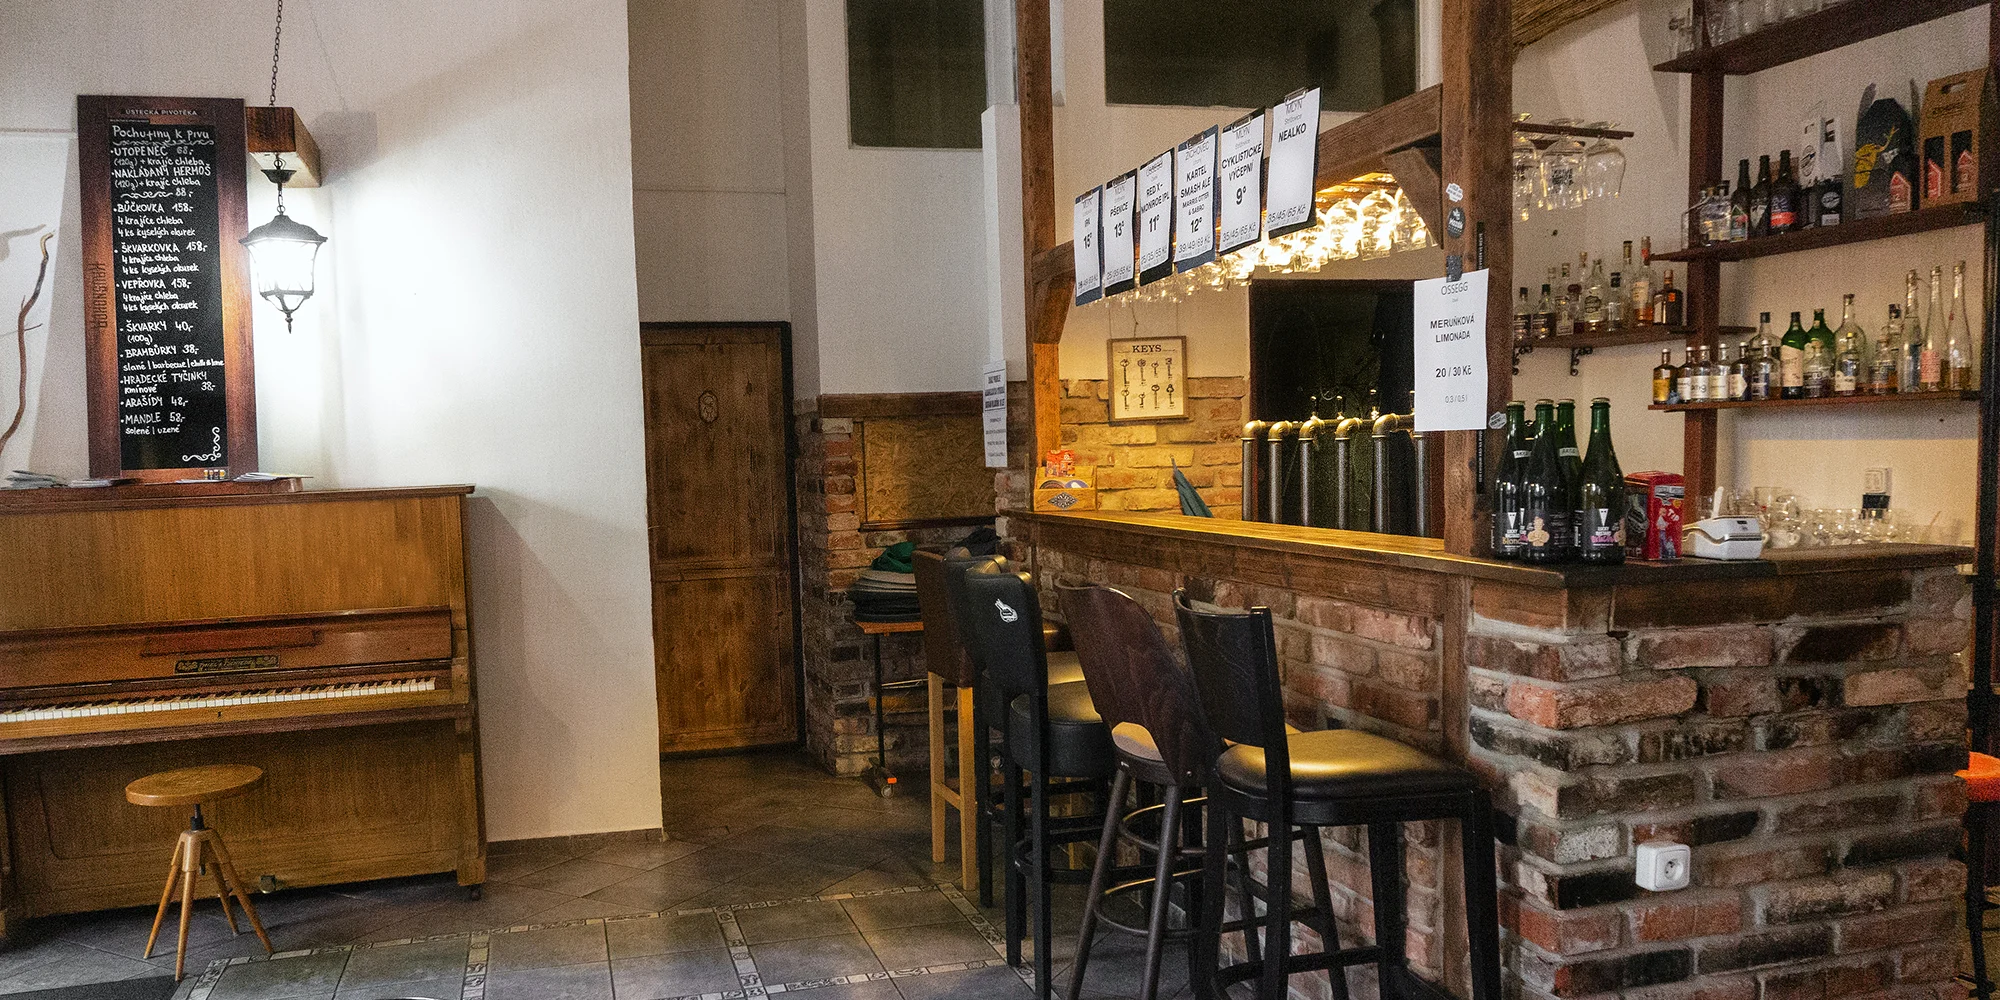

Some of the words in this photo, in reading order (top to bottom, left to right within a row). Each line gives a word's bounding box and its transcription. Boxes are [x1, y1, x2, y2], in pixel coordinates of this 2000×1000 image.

[112, 125, 171, 142] Pochutiny
[187, 130, 210, 140] pivu
[1279, 122, 1306, 142] NEALKO
[114, 146, 168, 156] UTOPENEC
[1222, 140, 1262, 169] CYKLISTICKÉ
[174, 157, 205, 166] chleba
[173, 164, 211, 176] HERMOŠ
[1186, 165, 1207, 182] KARTEL
[1228, 159, 1254, 182] VÝČEPNÍ
[172, 177, 201, 186] chleba
[1180, 184, 1200, 198] SMASH
[1202, 176, 1211, 190] ALE
[1146, 185, 1156, 198] RED
[1110, 202, 1128, 218] PŠENICE
[1141, 195, 1162, 214] MONROE
[1297, 204, 1306, 215] Kč
[118, 216, 124, 225] 4
[156, 216, 184, 224] chleba
[118, 228, 124, 237] 4
[124, 228, 134, 236] ks
[170, 228, 196, 236] okurek
[1249, 222, 1256, 232] Kč
[121, 240, 180, 253] ŠKVARKOVKA
[122, 254, 128, 264] 4
[154, 254, 180, 262] chleba
[122, 266, 128, 275] 4
[130, 266, 139, 274] ks
[121, 277, 166, 290] VEPŘOVKA
[1441, 282, 1468, 295] OSSEGG
[122, 292, 128, 302] 4
[154, 290, 180, 300] chleba
[126, 320, 168, 332] ŠKVARKY
[1430, 313, 1475, 329] MERUŇKOVÁ
[127, 334, 153, 346] (100g)
[124, 344, 177, 358] BRAMBŮRKY
[1132, 344, 1162, 353] KEYS
[122, 361, 146, 372] slané
[1436, 368, 1447, 378] 20
[1452, 366, 1462, 376] 30
[1462, 364, 1472, 376] Kč
[124, 370, 168, 385] HRADECKÉ
[170, 370, 207, 383] TYČINKY
[124, 384, 158, 394] kmínové
[125, 394, 163, 408] ARAŠÍDY
[125, 412, 162, 424] MANDLE
[125, 426, 150, 435] solené
[158, 424, 180, 434] uzené
[1668, 508, 1680, 522] TIP
